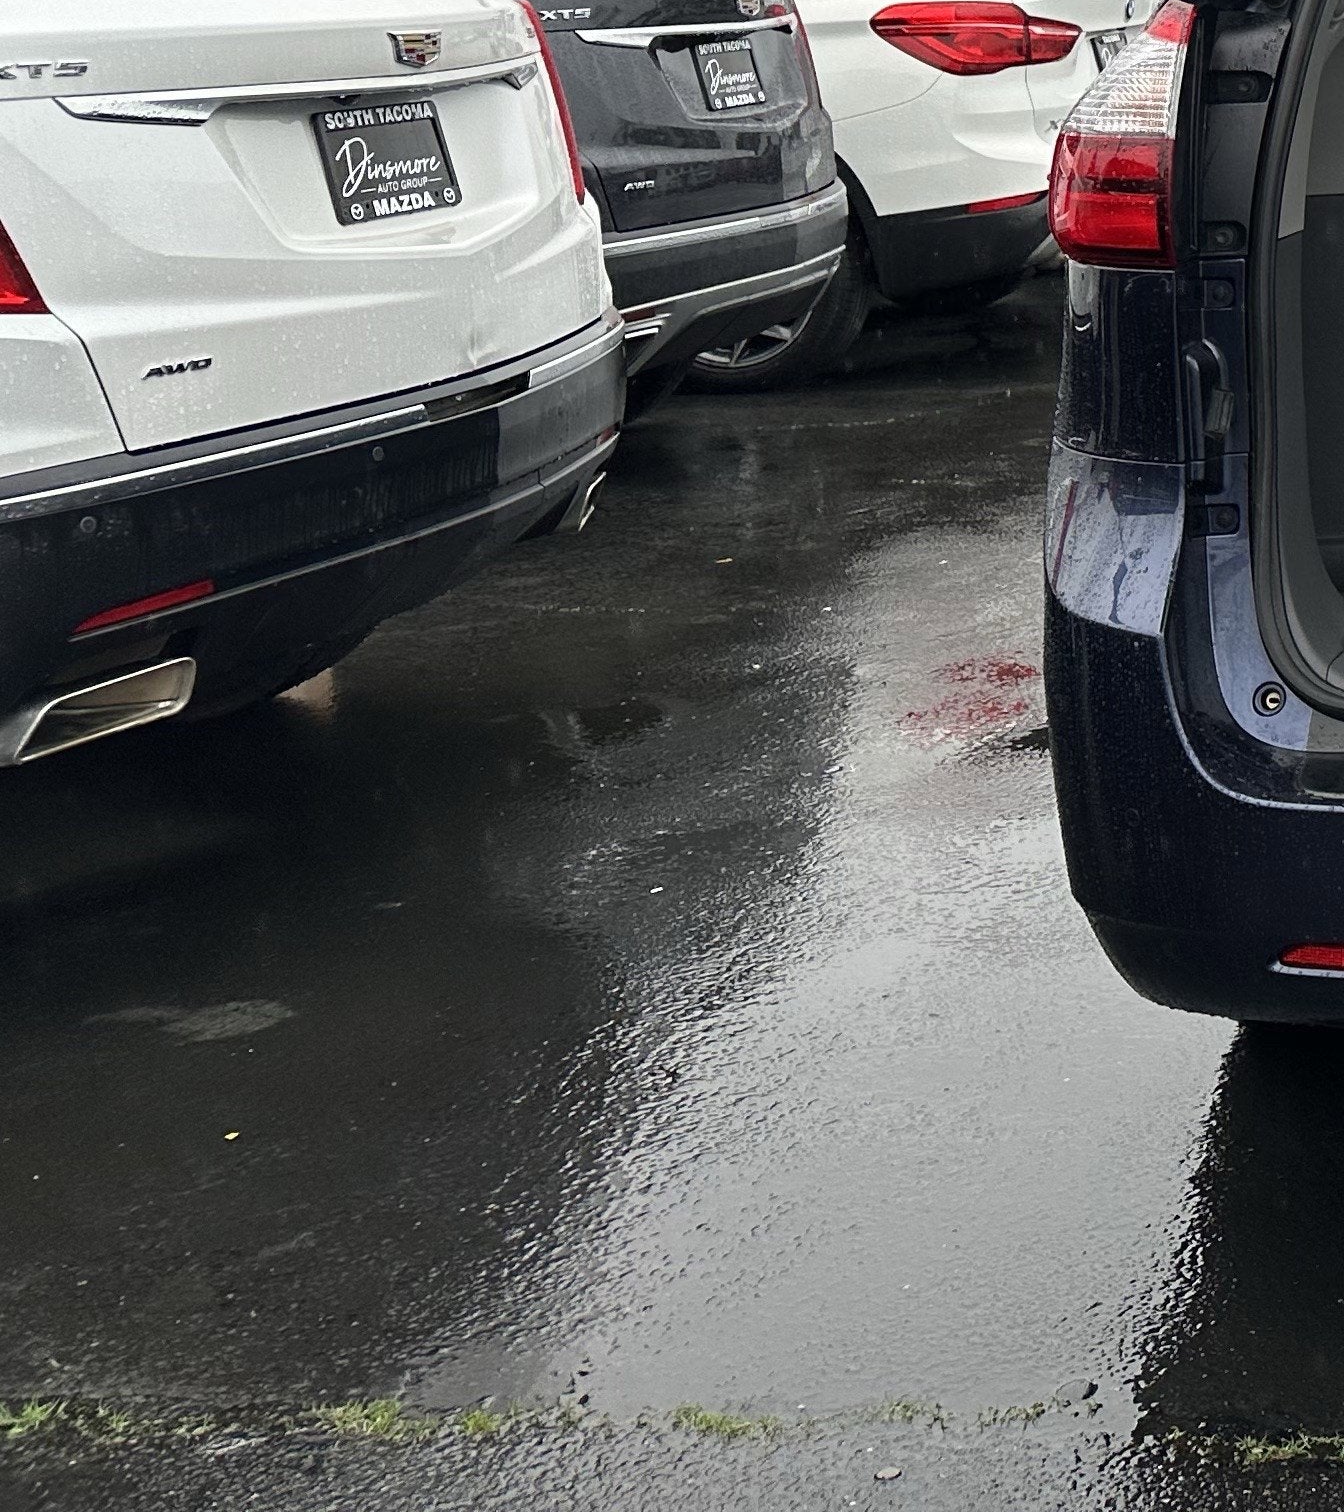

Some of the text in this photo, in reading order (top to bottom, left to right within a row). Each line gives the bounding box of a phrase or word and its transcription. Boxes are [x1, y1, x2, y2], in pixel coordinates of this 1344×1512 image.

[724, 92, 756, 108] MAZDA
[324, 102, 434, 129] SOUTH TACOMA
[335, 137, 440, 198] Dinsmore
[377, 176, 428, 193] AUTO GROUP
[372, 190, 435, 216] MAZDA
[140, 357, 213, 381] AWD
